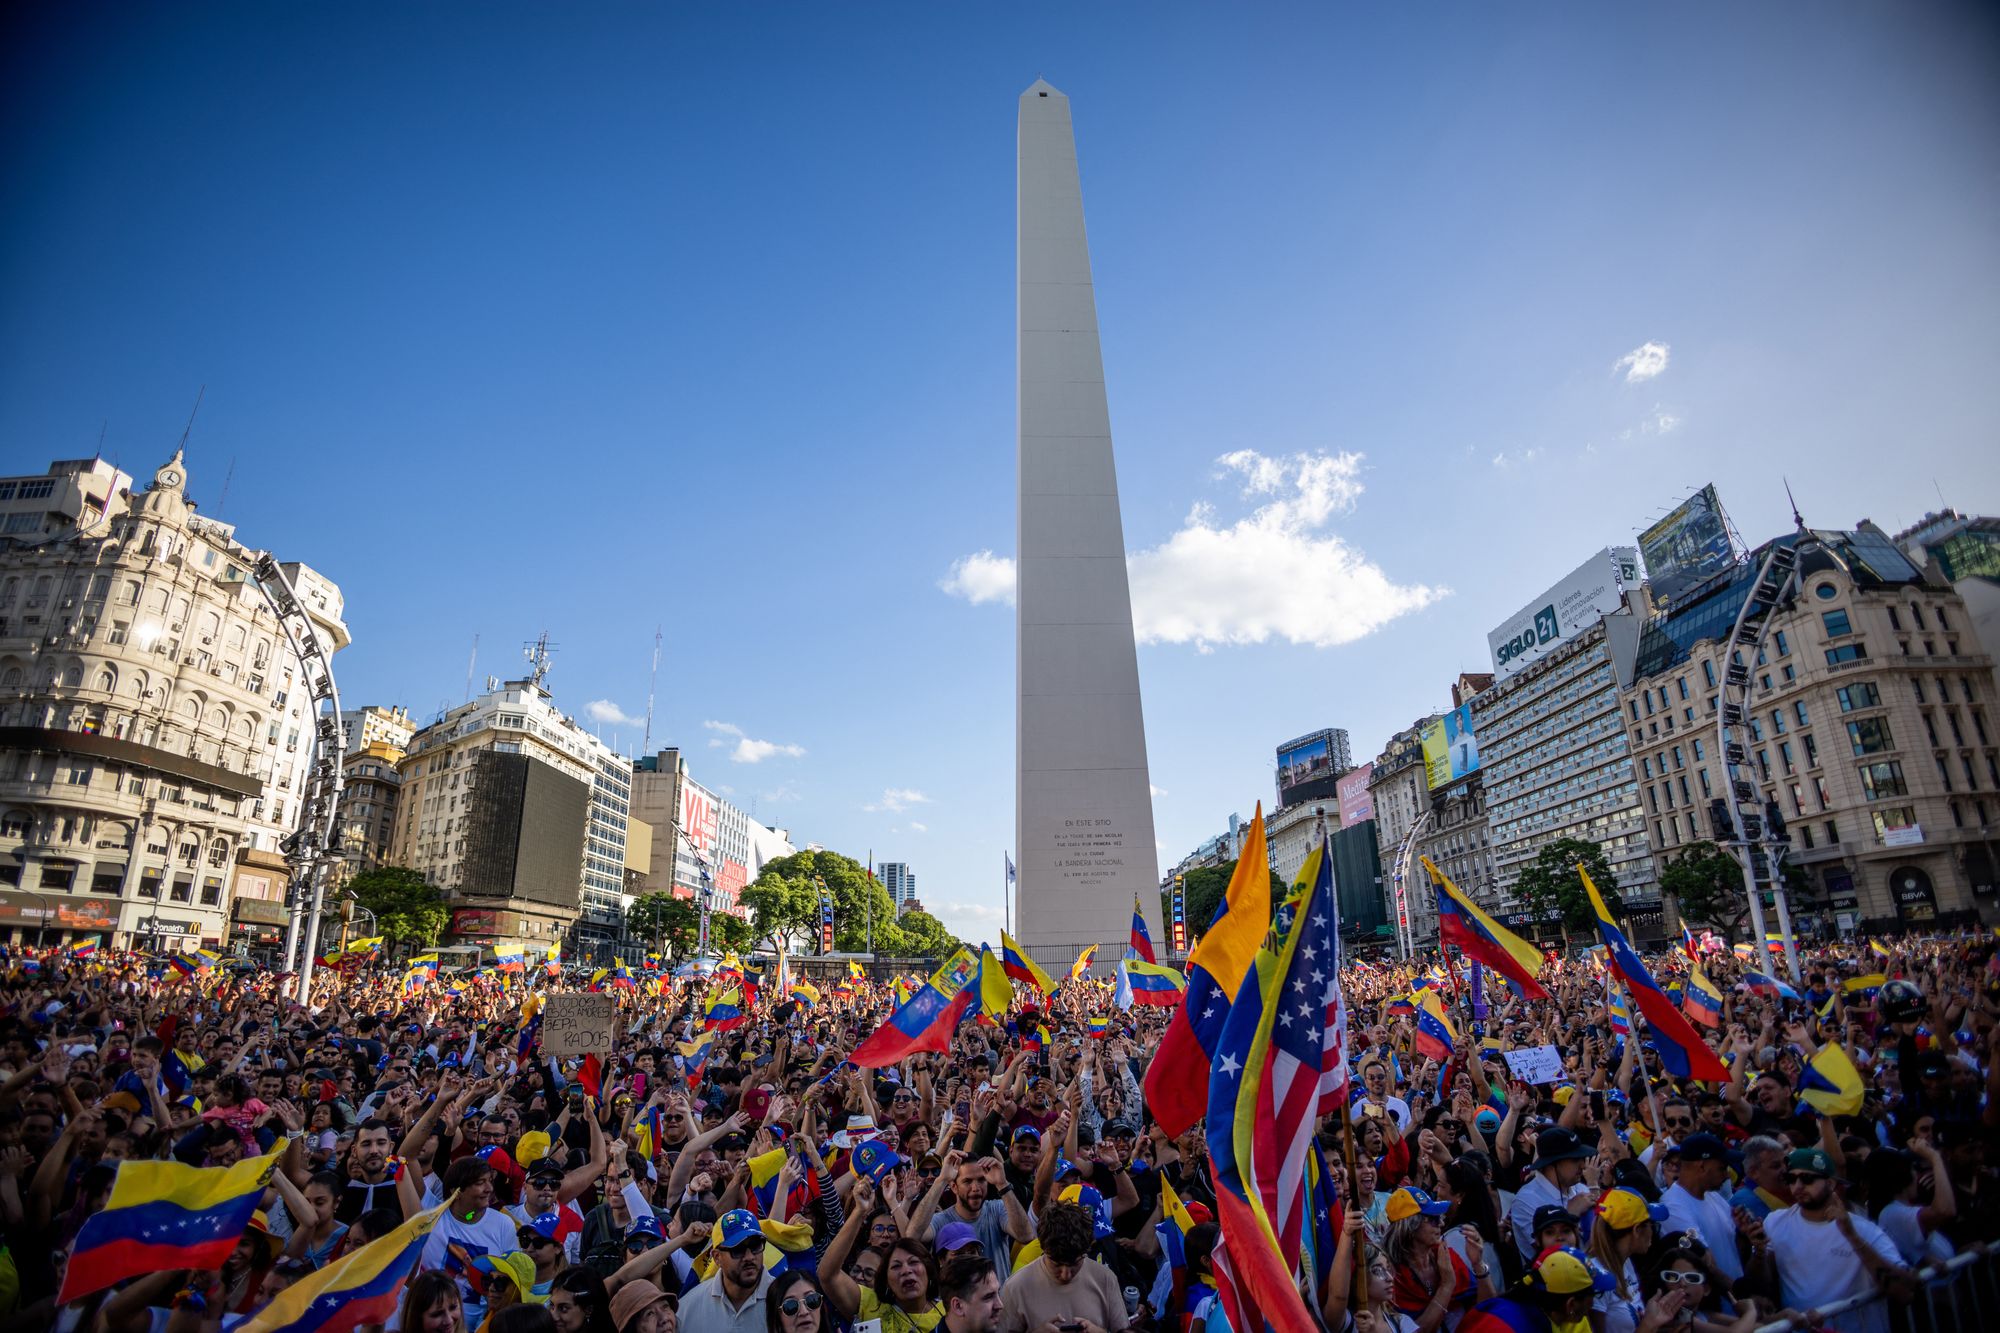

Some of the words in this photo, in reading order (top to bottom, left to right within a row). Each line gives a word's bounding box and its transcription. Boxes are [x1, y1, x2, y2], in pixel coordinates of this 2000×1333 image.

[1623, 567, 1637, 580] 21
[1558, 589, 1582, 610] Líderes
[1561, 610, 1570, 619] en
[1569, 585, 1605, 613] innovación
[1496, 628, 1536, 666] SIGLO
[1538, 616, 1554, 639] 21
[1065, 819, 1074, 827] EN
[1076, 819, 1093, 827] ESTE
[1065, 859, 1092, 867] BANDERA
[1094, 858, 1124, 866] NACIONAL
[1901, 891, 1926, 900] BBVA
[1833, 900, 1851, 908] BBVA
[547, 997, 555, 1008] A
[545, 1007, 575, 1018] ESOS
[577, 1006, 610, 1018] AMORES
[544, 1018, 577, 1031] SEPA
[563, 1030, 610, 1048] RADOS
